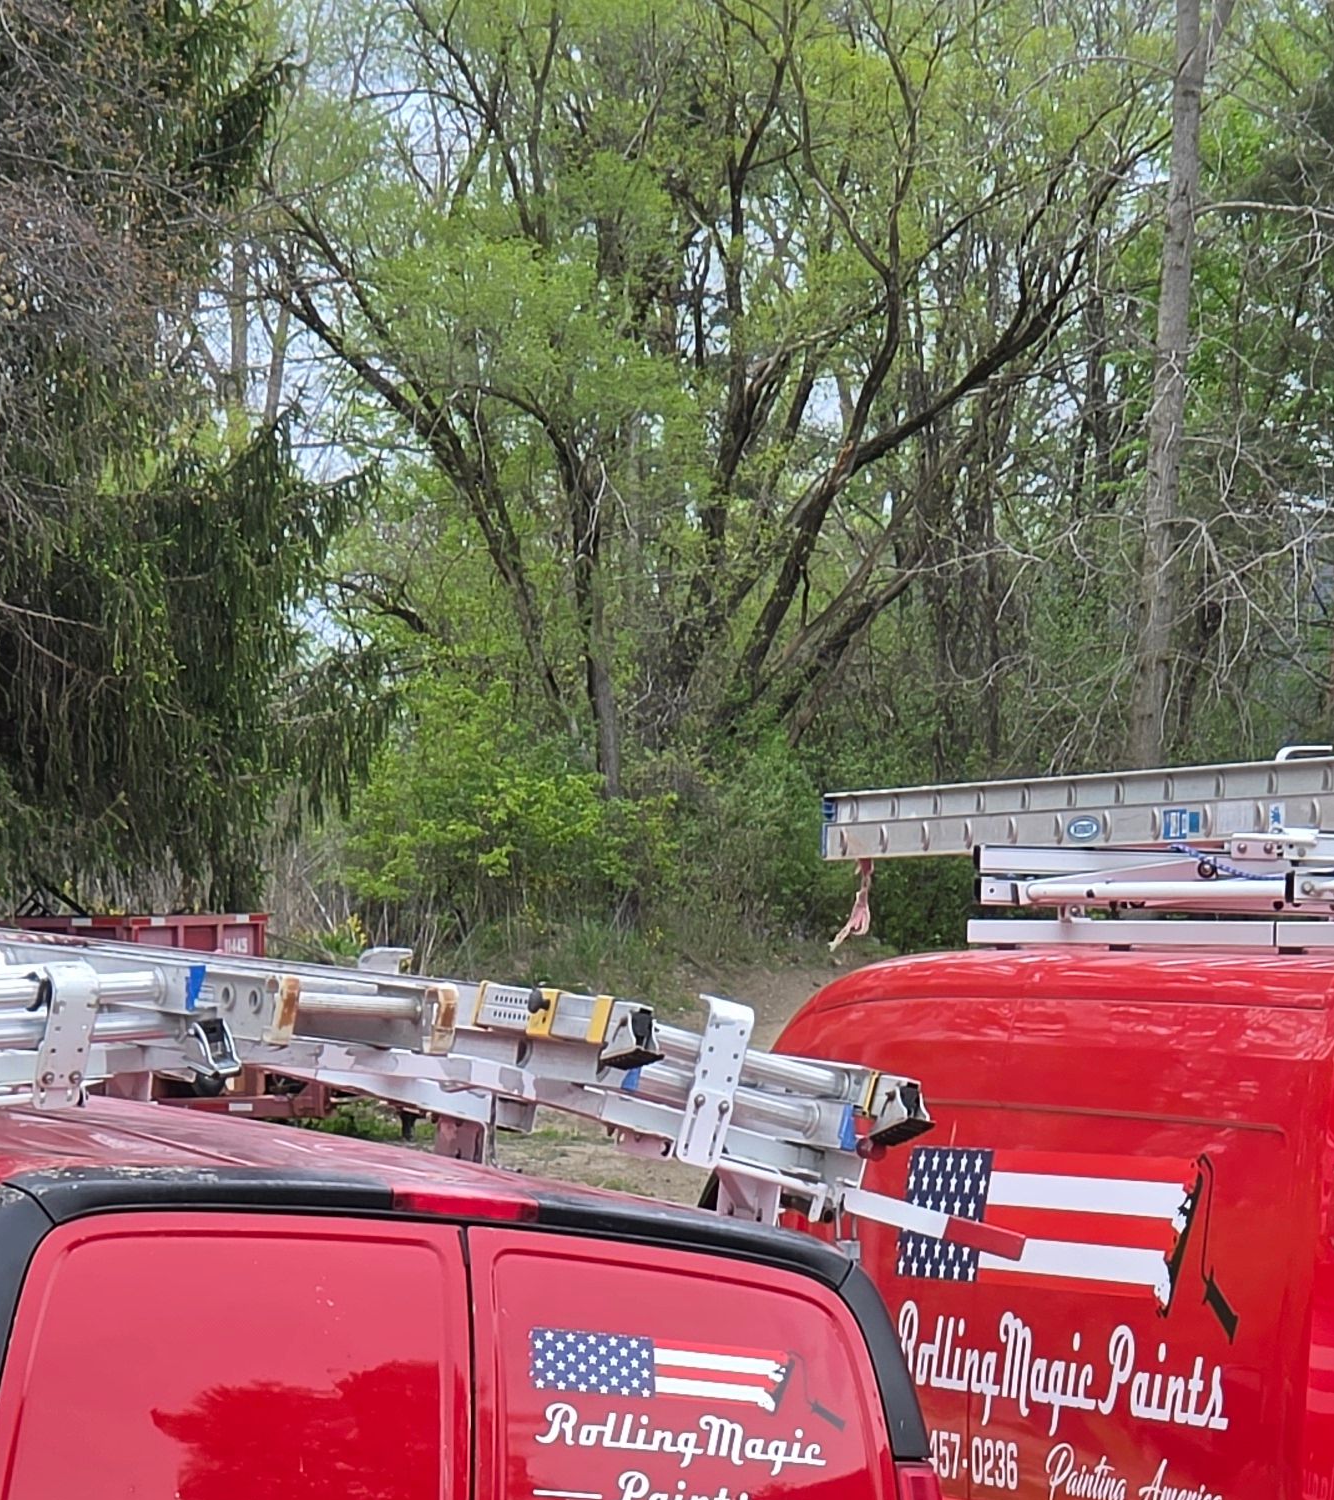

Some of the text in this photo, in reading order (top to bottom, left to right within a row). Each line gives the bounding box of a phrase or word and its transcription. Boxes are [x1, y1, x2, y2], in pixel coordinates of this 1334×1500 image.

[897, 1300, 1229, 1437] Rolling Magic Paints
[534, 1402, 827, 1476] Rolling Magic
